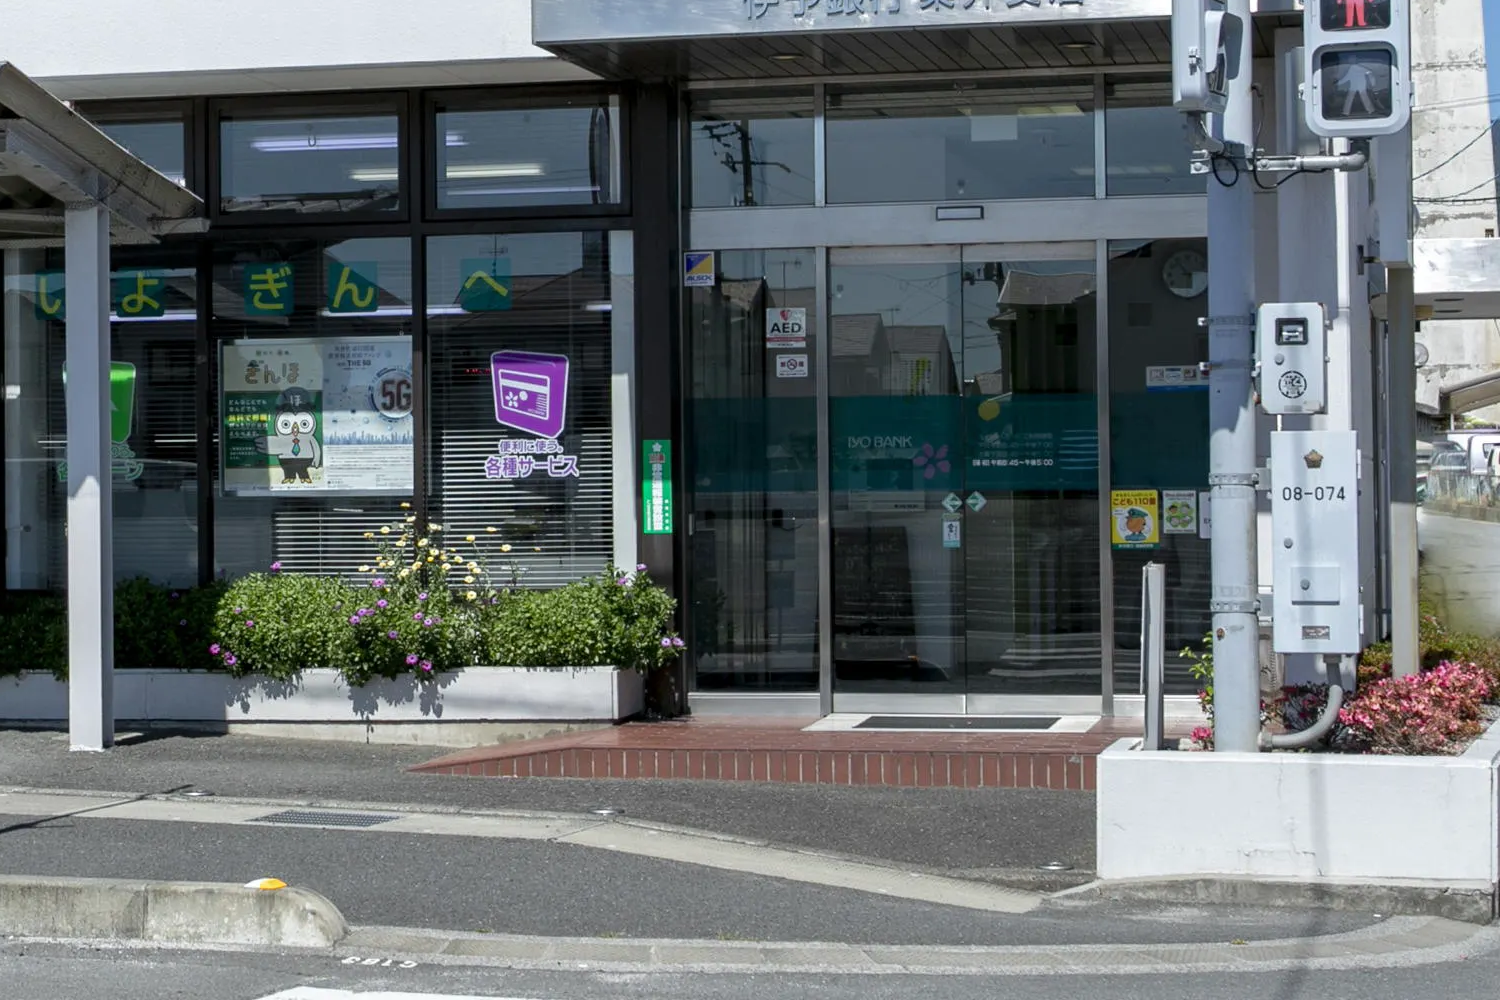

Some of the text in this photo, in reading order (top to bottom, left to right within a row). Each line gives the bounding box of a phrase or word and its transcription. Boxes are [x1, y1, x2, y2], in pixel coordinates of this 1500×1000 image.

[770, 322, 802, 334] AED
[381, 379, 411, 411] 5G
[499, 439, 564, 454] 便利に使う。
[848, 436, 912, 448] IYO BANK
[485, 455, 580, 478] 各種サービス
[1282, 486, 1346, 502] 08-074
